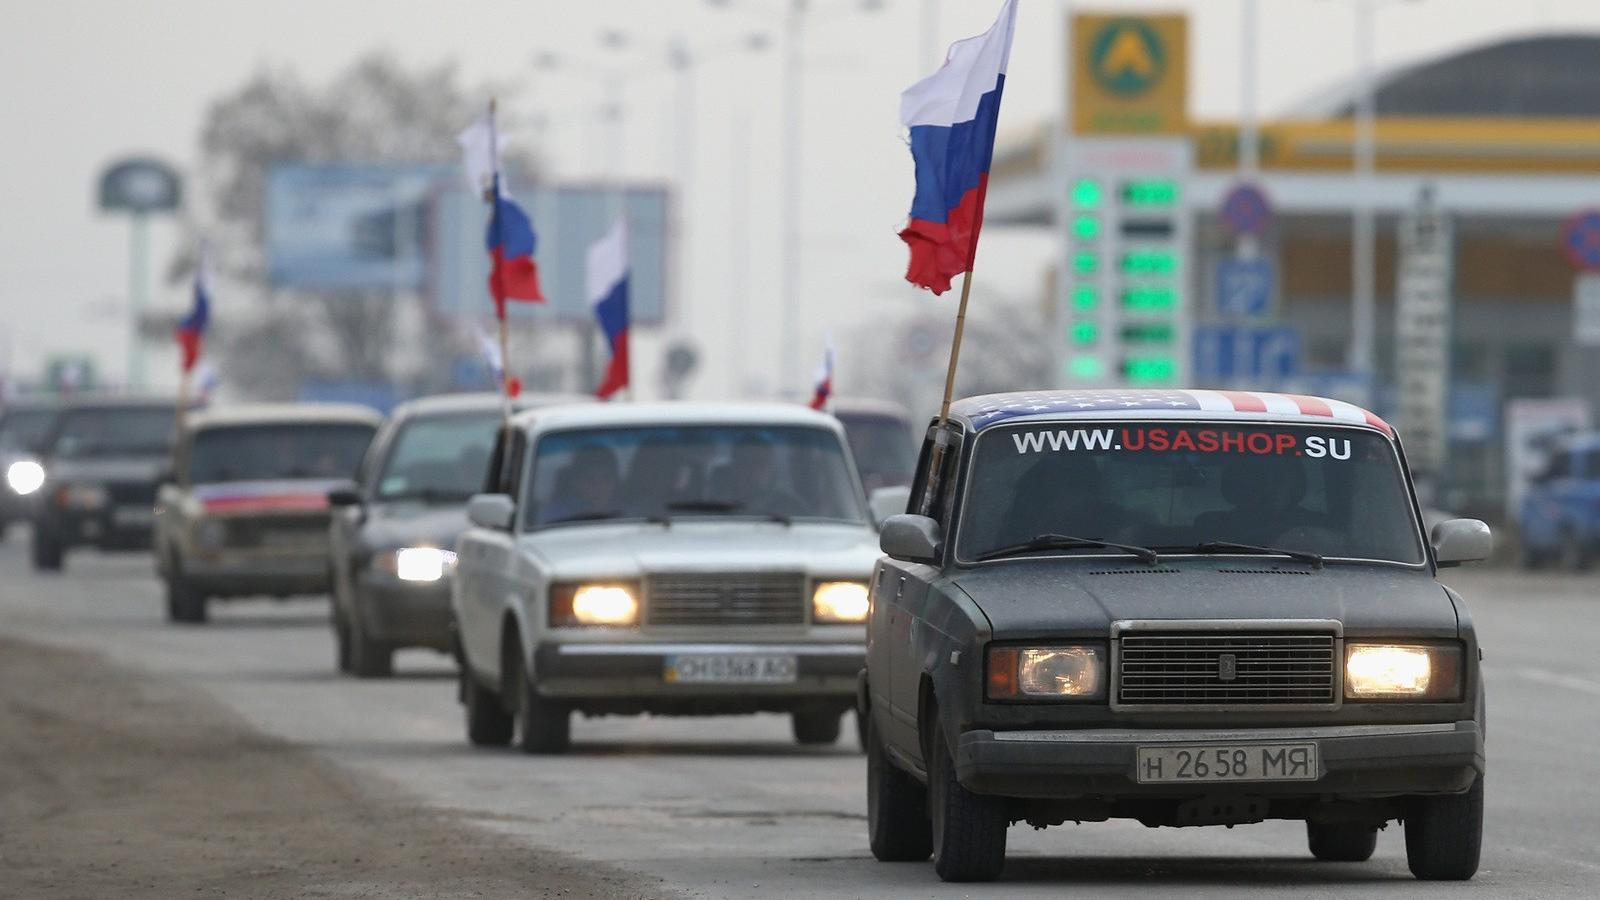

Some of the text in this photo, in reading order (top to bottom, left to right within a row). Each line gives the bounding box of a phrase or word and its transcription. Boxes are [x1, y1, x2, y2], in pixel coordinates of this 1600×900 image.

[1012, 429, 1351, 460] WWW.USASHOP.SU
[1176, 749, 1248, 778] 2658
[1262, 747, 1309, 777] МЯ
